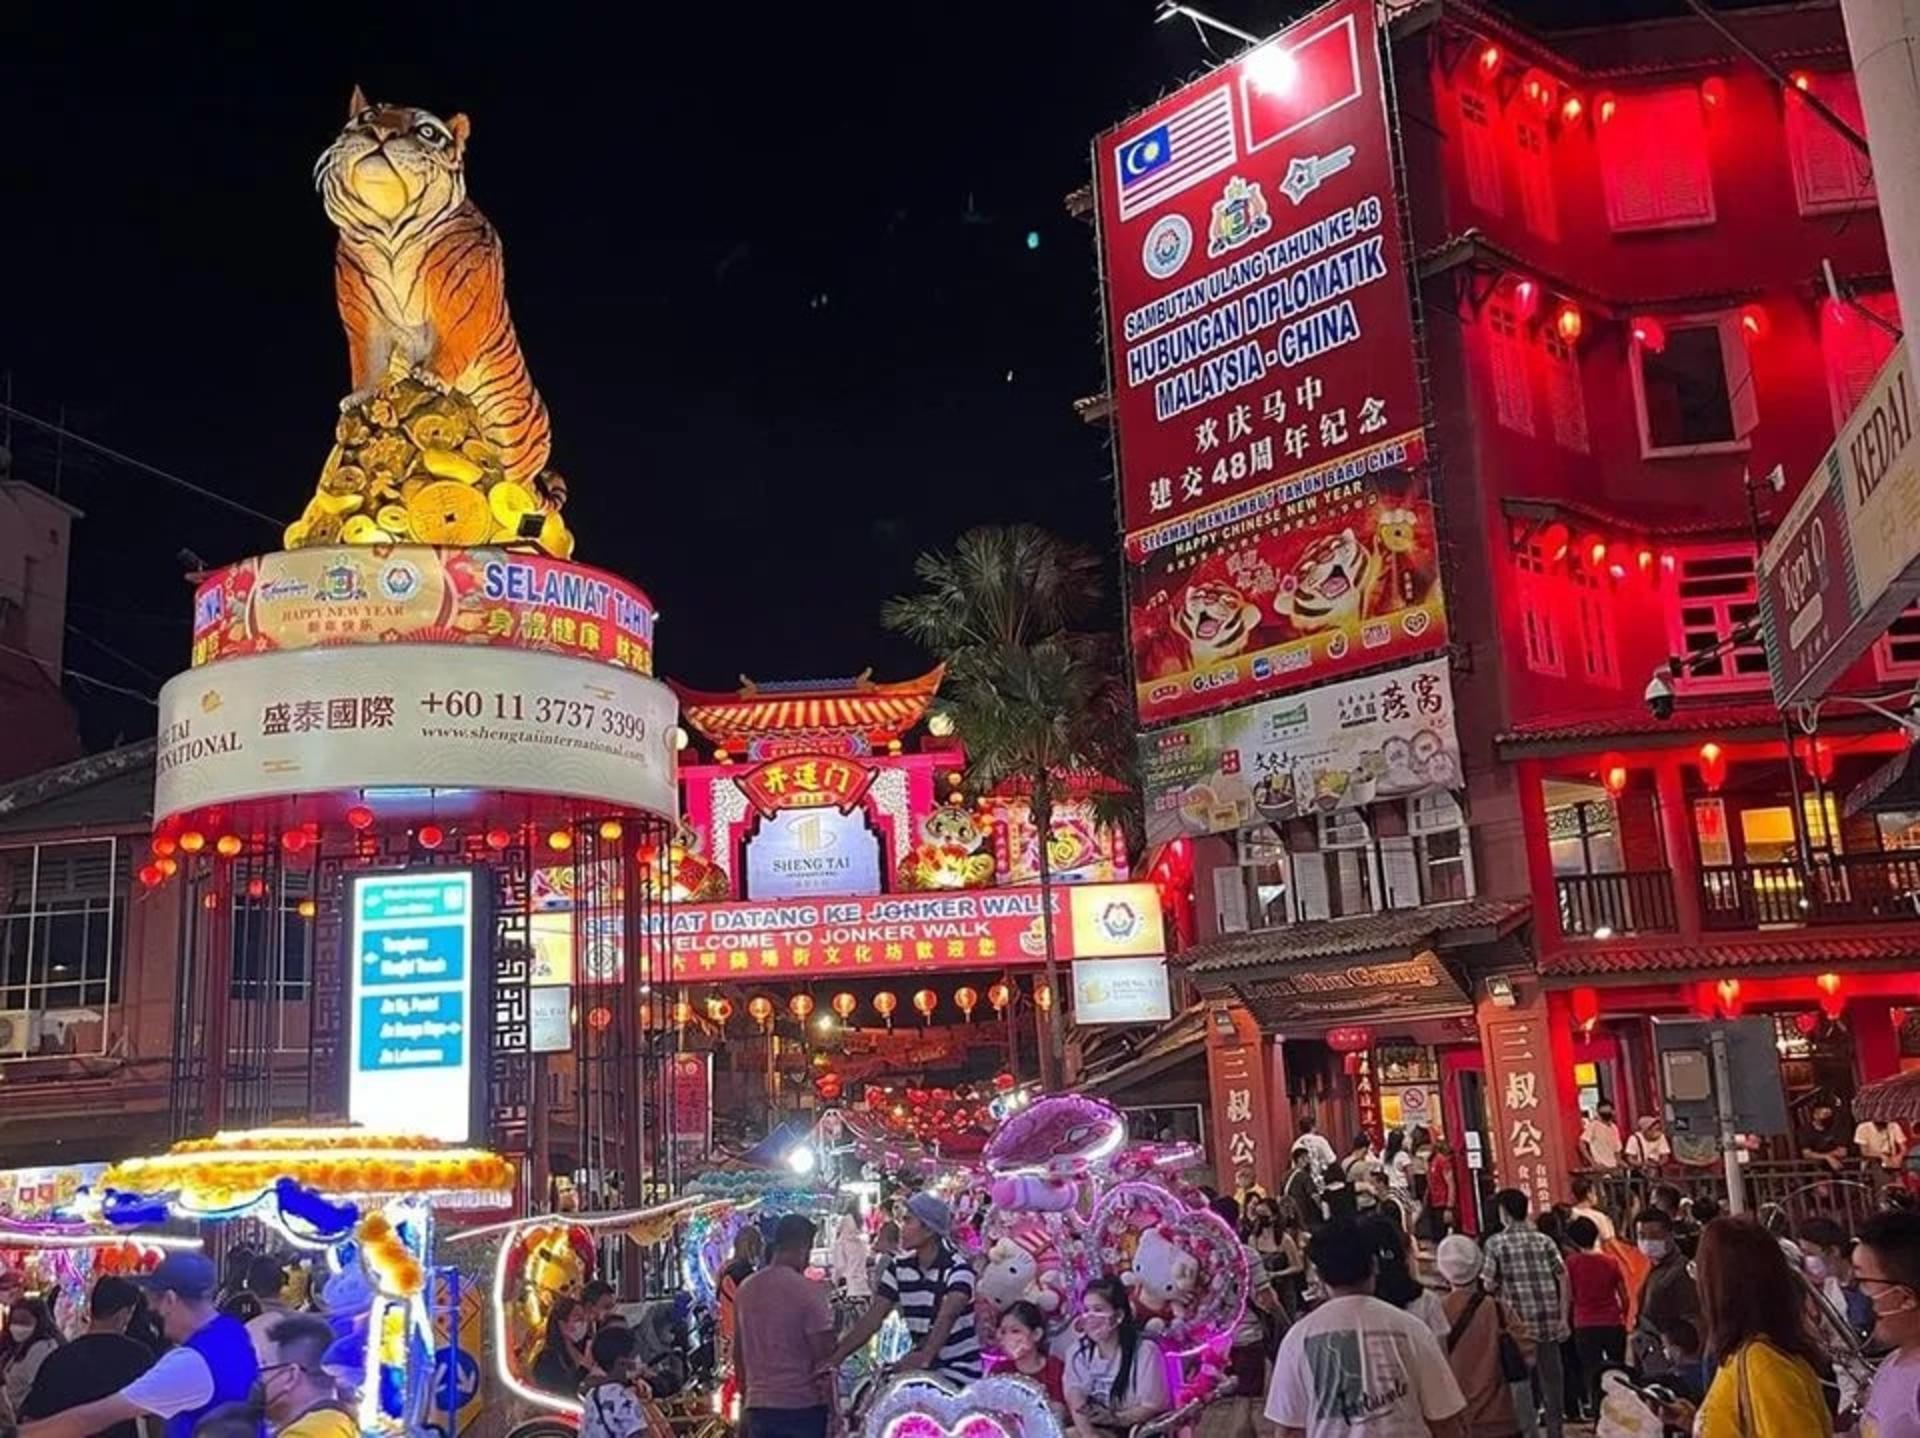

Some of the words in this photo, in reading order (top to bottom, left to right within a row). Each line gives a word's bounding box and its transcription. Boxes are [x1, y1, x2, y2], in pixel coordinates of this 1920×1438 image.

[1126, 286, 1206, 338] SAMBUTAN
[1209, 256, 1264, 299] ULANG
[1266, 226, 1325, 273] TAHUN
[1328, 211, 1354, 242] KE
[1357, 200, 1378, 231] 48
[1129, 304, 1241, 384] HUBUNGAN
[1248, 238, 1385, 331] DIPLOMATIK
[1157, 344, 1264, 419] MALAYSIA
[1280, 304, 1358, 364] CHINA
[1195, 375, 1323, 452] 欢庆马中
[1850, 371, 1911, 506] KEDAI
[1141, 524, 1194, 553] SELAMAT
[1197, 490, 1275, 536] MENYAMBUT
[1278, 476, 1322, 506] TAHUN
[1326, 460, 1366, 487] BARU
[1369, 444, 1407, 473] CINA
[1175, 533, 1217, 556] HAPPY
[1222, 510, 1281, 540] CHINESE
[1287, 498, 1317, 518] NEW
[1323, 480, 1364, 505] YEAR
[282, 608, 325, 622] HAPPY
[327, 606, 361, 618] NEW
[364, 605, 405, 618] YEAR
[485, 562, 609, 618] SELAMAT
[262, 696, 395, 736] 盛泰國際
[421, 690, 482, 718] +60
[495, 693, 524, 721] 11
[535, 697, 595, 730] 3737
[601, 707, 646, 743] 3399
[773, 858, 823, 873] SHENG
[827, 857, 850, 870] TAI
[653, 931, 776, 953] WELCOME
[783, 930, 813, 946] TO
[819, 925, 916, 945] JONKER
[922, 922, 991, 938] WALK
[713, 907, 817, 932] DATANG
[826, 905, 861, 923] KE
[869, 899, 974, 923] JONKER
[1223, 1047, 1257, 1166] 三叔公
[1501, 1024, 1543, 1158] 三叔公
